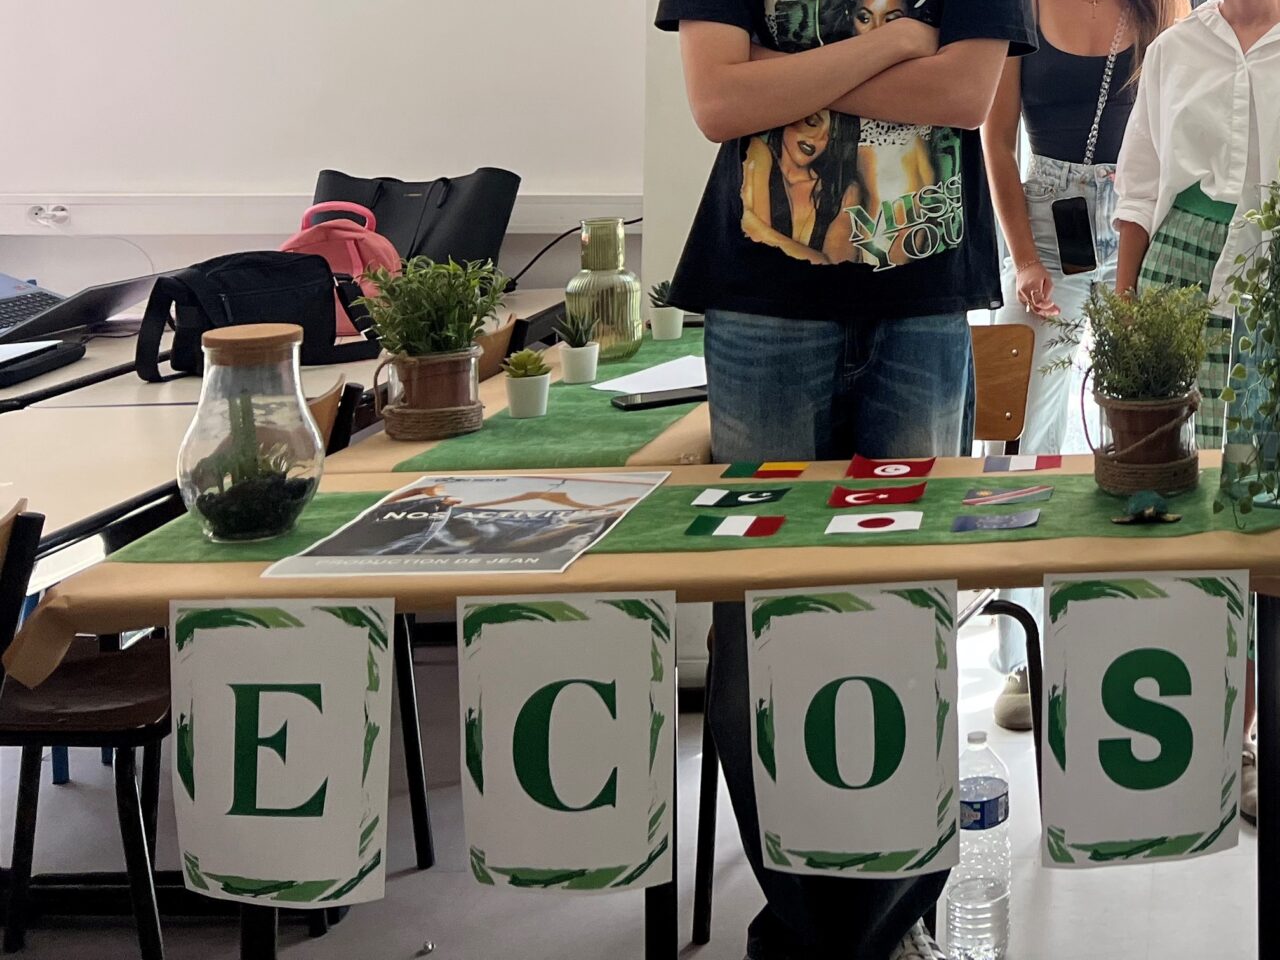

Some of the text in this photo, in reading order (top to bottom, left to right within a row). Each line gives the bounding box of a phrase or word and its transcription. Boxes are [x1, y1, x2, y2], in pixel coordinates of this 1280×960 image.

[844, 174, 963, 241] MISS
[852, 208, 964, 273] YOU
[453, 556, 479, 565] DE
[485, 556, 541, 565] JEAN
